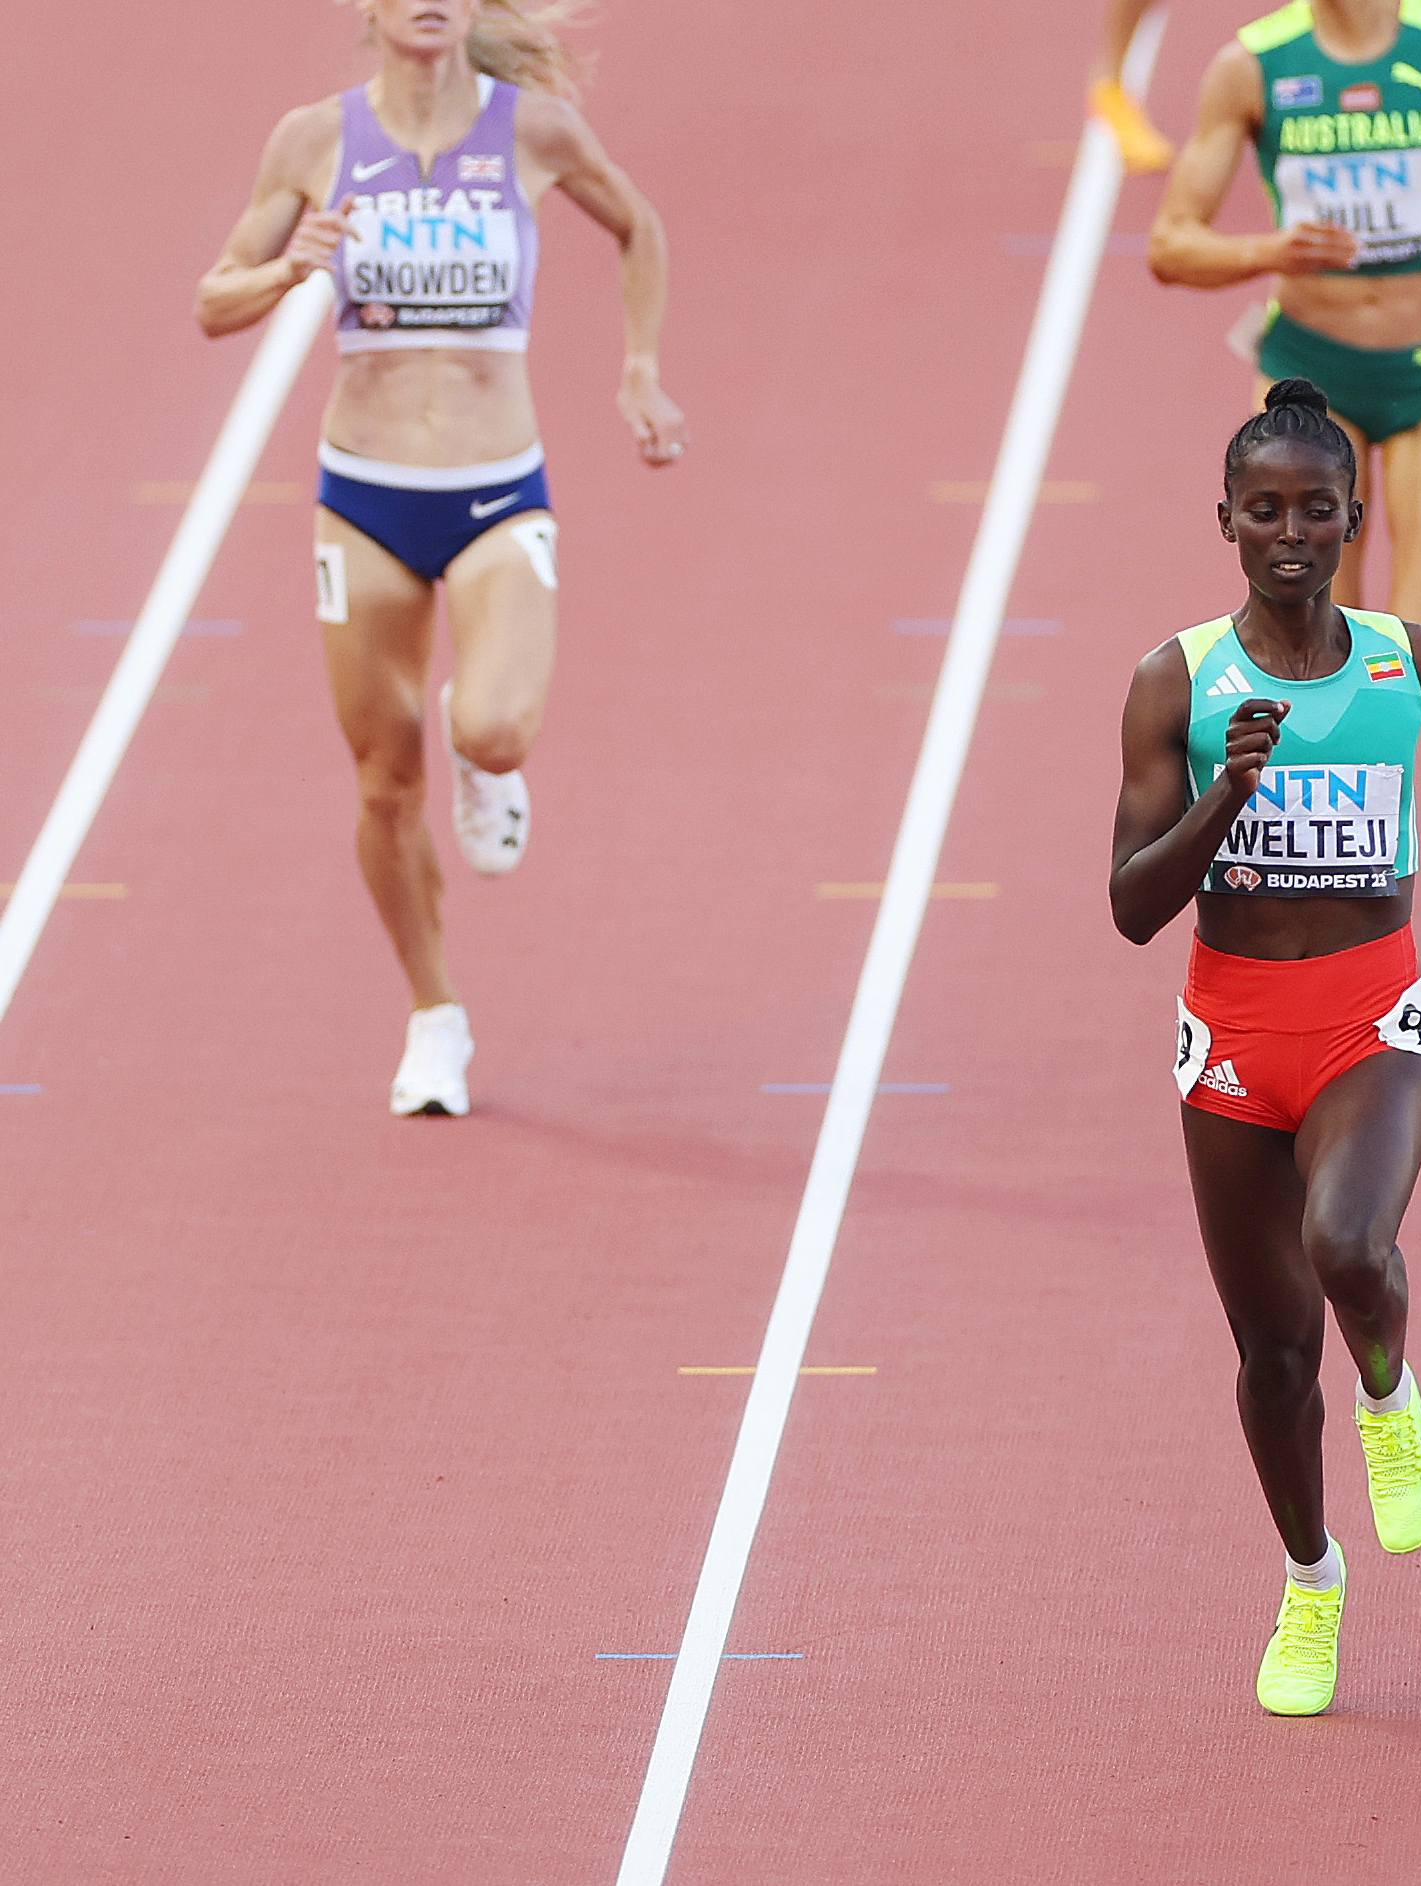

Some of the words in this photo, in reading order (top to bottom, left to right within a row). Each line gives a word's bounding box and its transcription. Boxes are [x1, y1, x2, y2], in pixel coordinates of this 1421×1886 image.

[1306, 153, 1409, 192] NTN
[380, 214, 487, 250] NTN
[355, 261, 507, 296] SNOWDEN
[1246, 770, 1368, 814] NTN
[1226, 819, 1387, 860] WELTEJI
[1267, 873, 1369, 889] BUDAPEST
[1371, 874, 1388, 888] 23
[1198, 1074, 1248, 1097] adidas
